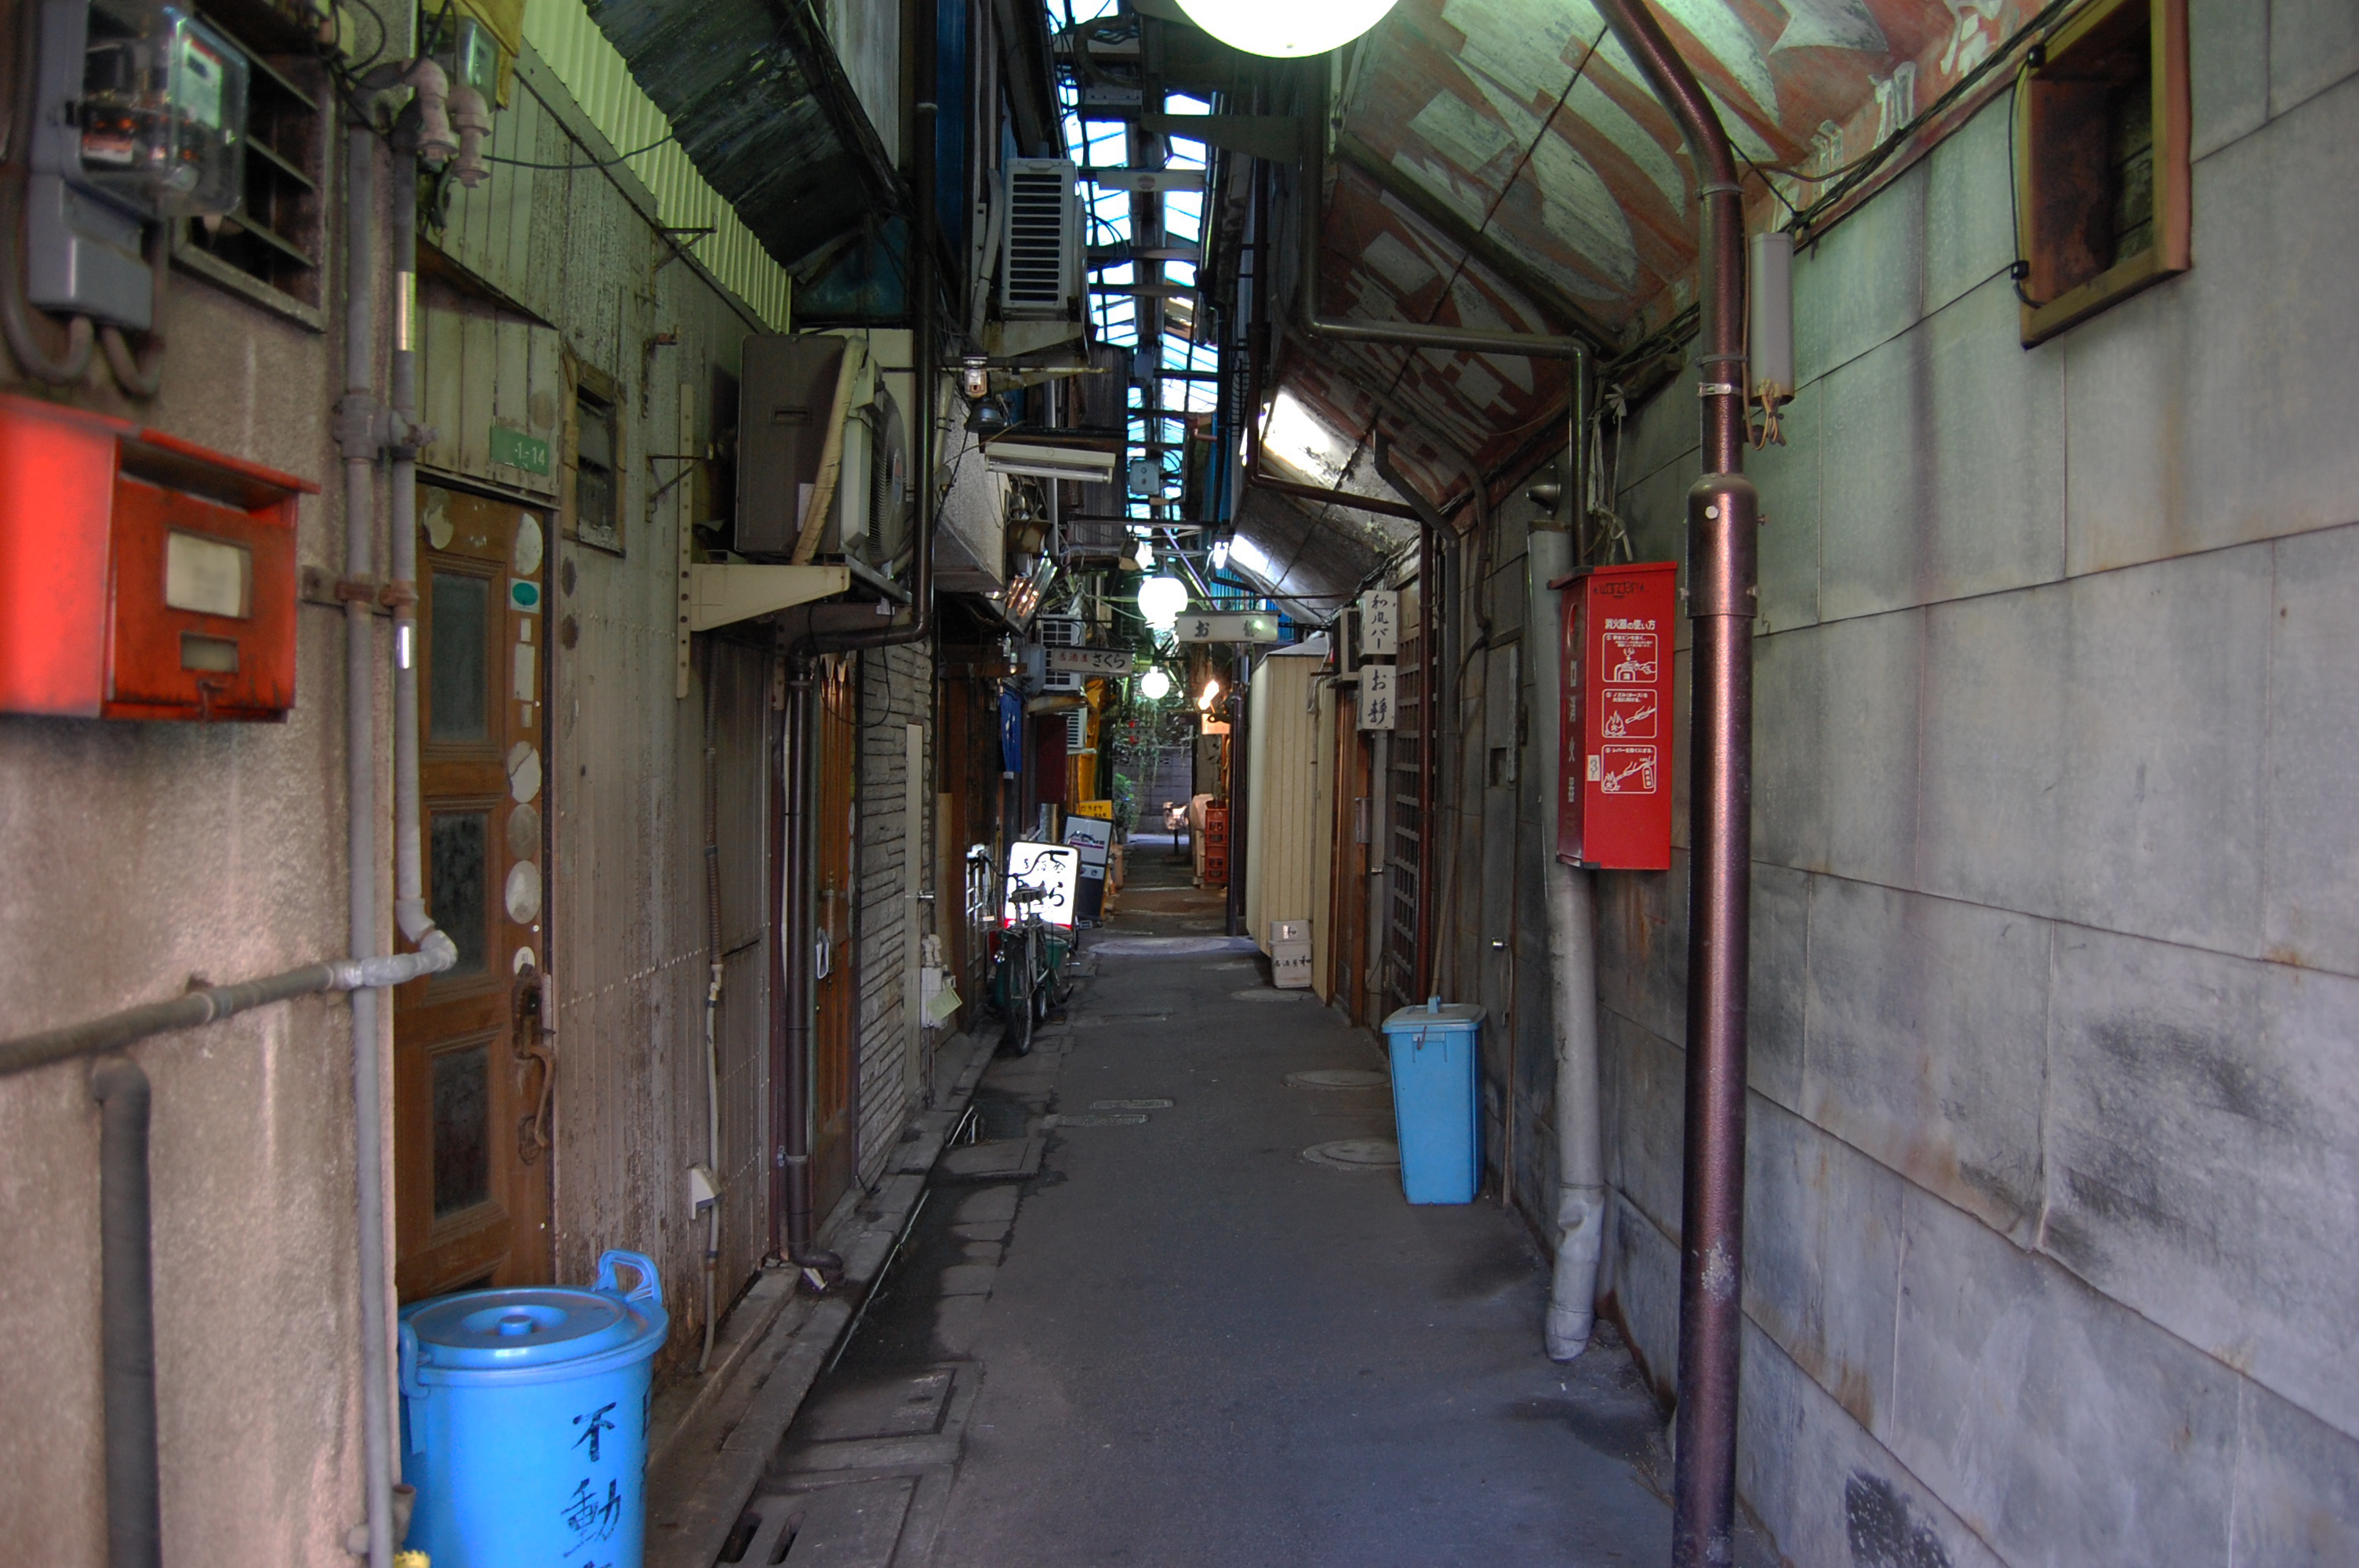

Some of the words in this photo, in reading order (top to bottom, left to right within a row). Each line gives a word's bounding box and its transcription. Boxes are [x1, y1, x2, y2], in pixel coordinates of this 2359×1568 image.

[1372, 593, 1389, 650] 和風バー
[1605, 619, 1656, 630] 消火器の使い方
[1092, 652, 1125, 669] さくら
[561, 1401, 622, 1568] 不動
